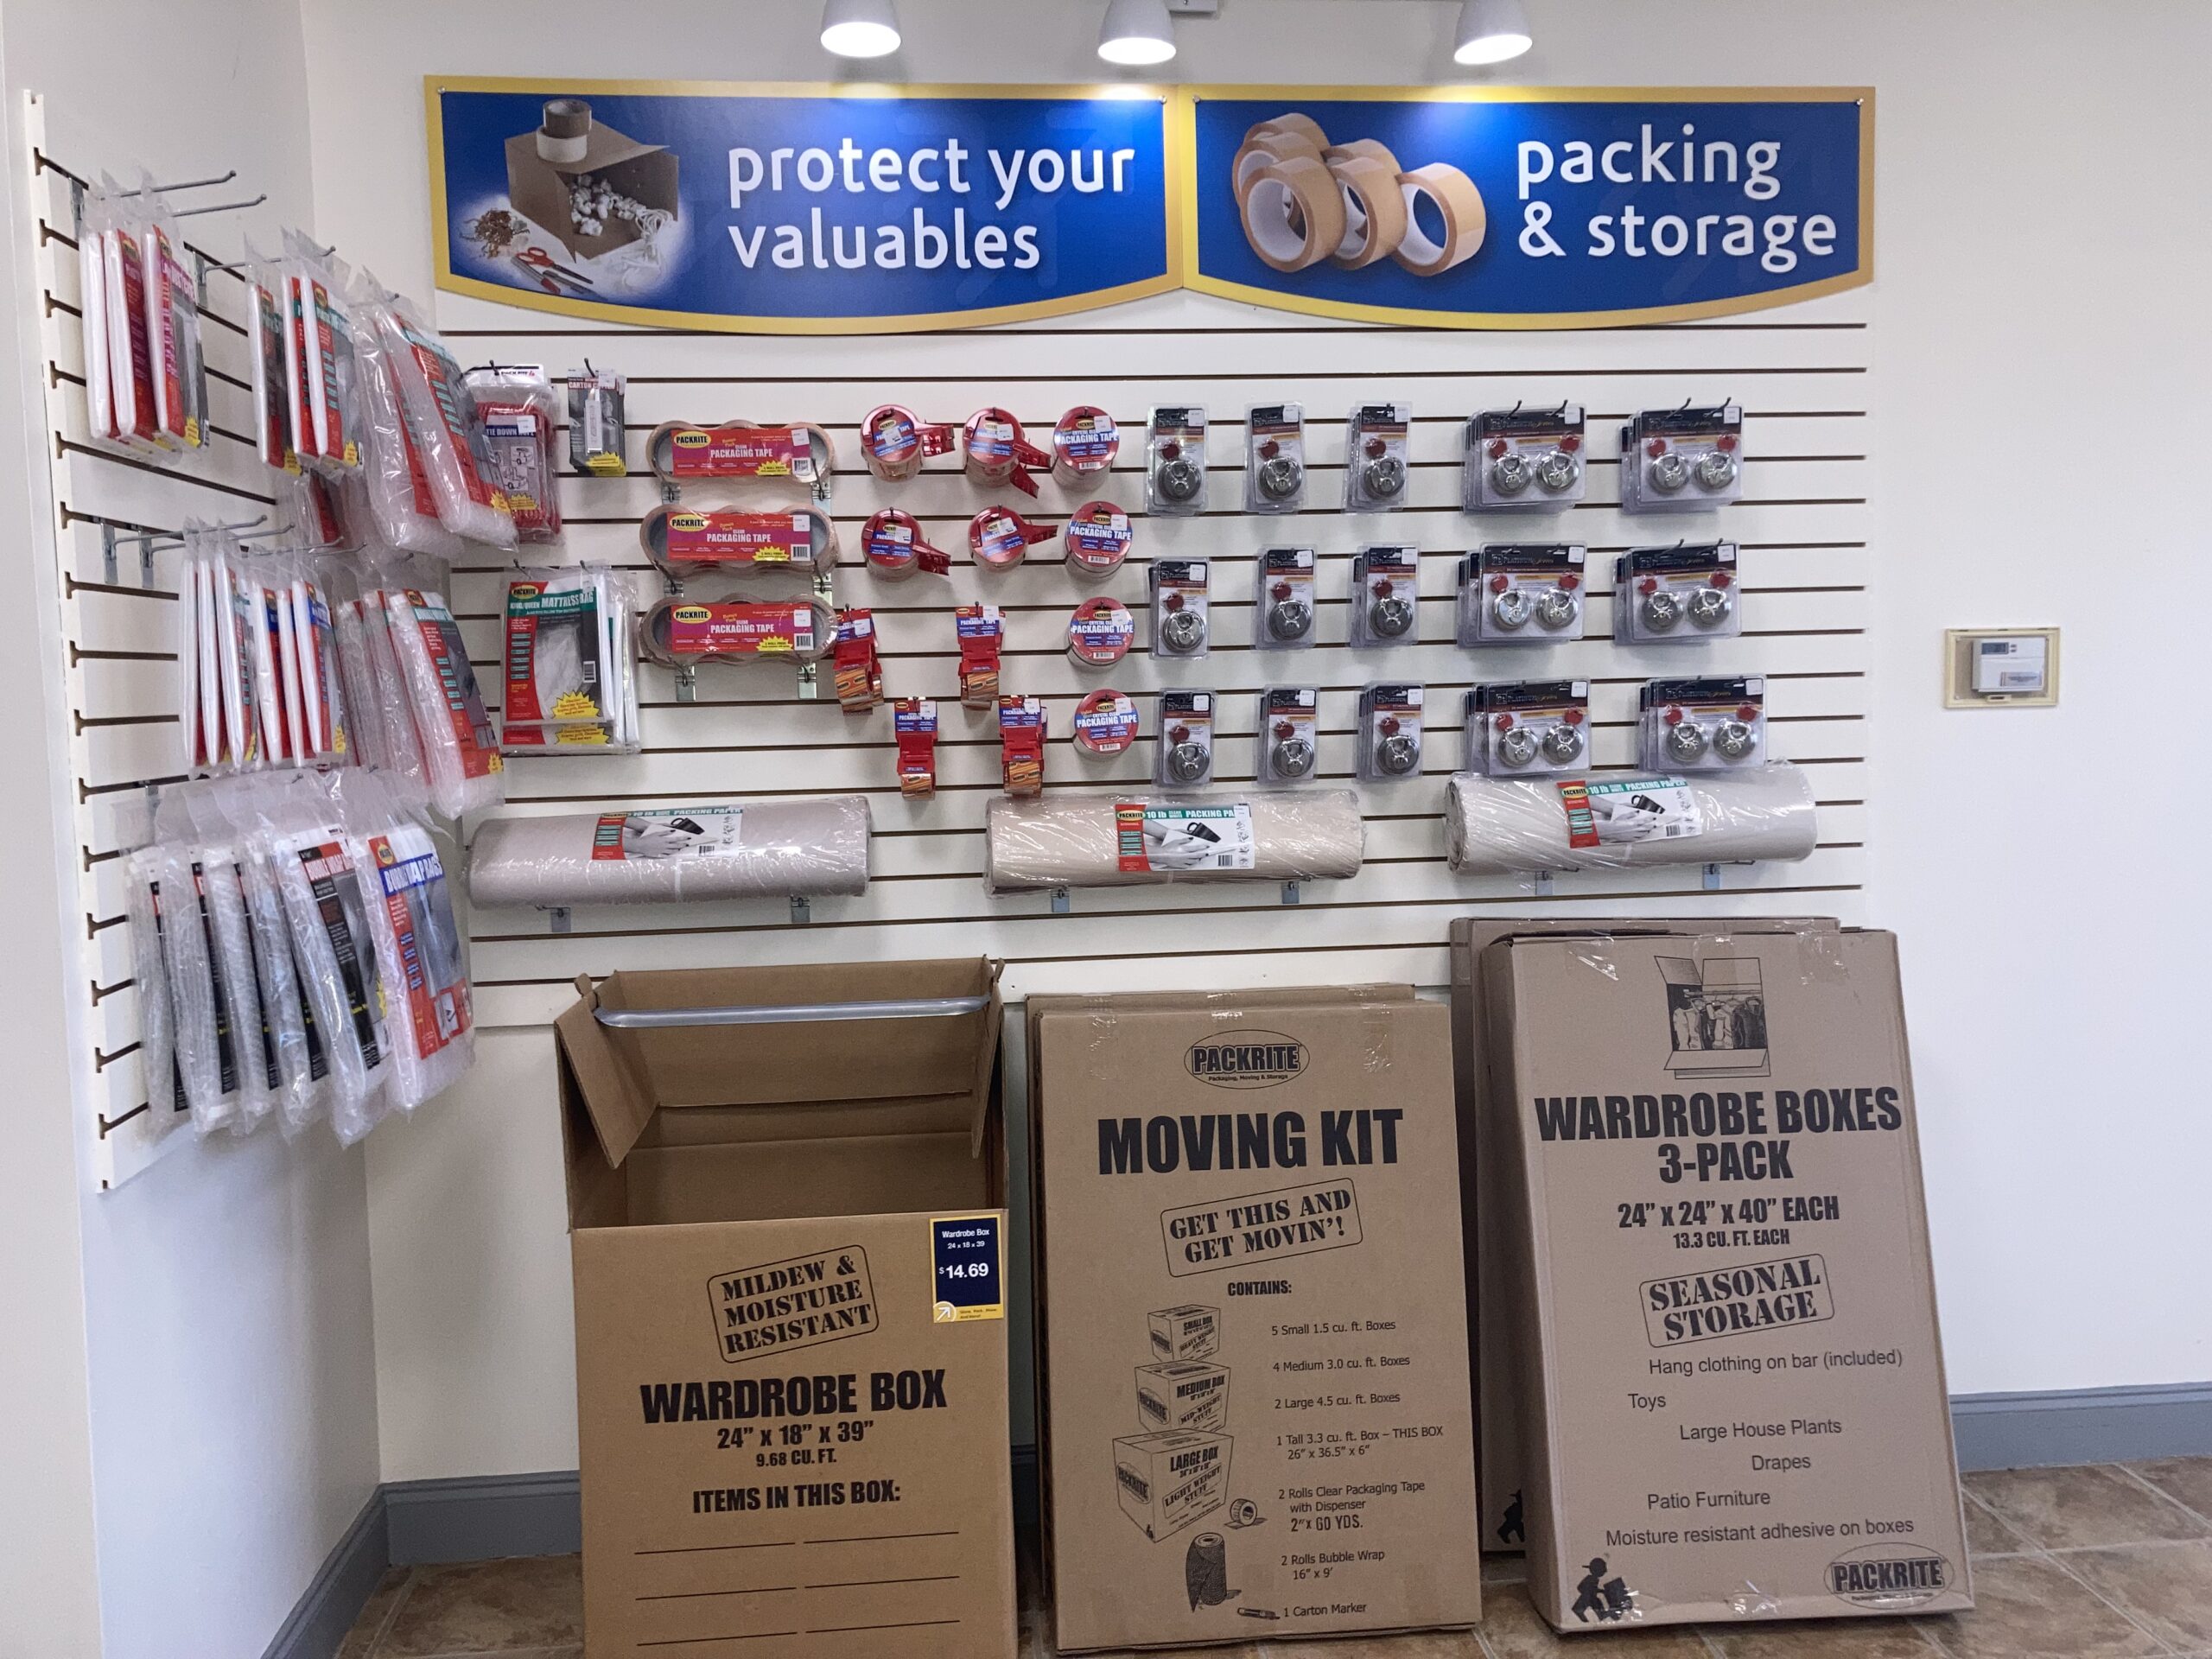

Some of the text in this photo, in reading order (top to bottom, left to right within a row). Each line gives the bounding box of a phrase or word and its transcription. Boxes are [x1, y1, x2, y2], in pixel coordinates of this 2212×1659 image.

[1517, 124, 1782, 200] packing
[729, 137, 1135, 209] protect your
[728, 207, 1039, 270] valuables
[1518, 202, 1837, 272] & storage
[677, 435, 708, 444] PACKRITE
[1100, 433, 1118, 442] TAPE
[710, 448, 772, 458] PACKAGING TAPE
[707, 533, 772, 543] PACKAGING TAPE
[1070, 526, 1132, 541] PACKAGING TAPE
[541, 592, 594, 608] MATTRESS BAG
[710, 624, 775, 633] PACKAGING TAPE
[1072, 625, 1134, 633] PACKAGING TAPE
[1077, 714, 1137, 728] PACKAGING TAPE
[1563, 787, 1586, 796] PACKRITE
[1588, 786, 1599, 795] 10
[1599, 785, 1609, 794] lb
[1624, 781, 1660, 791] PACKING
[1661, 779, 1688, 788] PAPER
[1146, 810, 1156, 819] 10
[1185, 810, 1222, 818] PACKING
[1192, 1046, 1300, 1073] PACKRITE
[1533, 1085, 1903, 1141] WARDROBE BOXES
[1097, 1108, 1404, 1175] MOVING KIT
[1656, 1140, 1795, 1184] 3-PACK
[1169, 1188, 1352, 1241] GET THIS AND
[1617, 1195, 1840, 1229] 24" 24" 40" EACH
[941, 1228, 990, 1239] Wardrobe Box
[1184, 1215, 1346, 1265] GET MOVIN'!
[1672, 1228, 1791, 1249] 13.3 CU. FT. EACH
[720, 1254, 857, 1302] MILDEW &
[1227, 1280, 1293, 1296] CONTAINS:
[1648, 1258, 1821, 1313] SEASONAL
[723, 1279, 864, 1328] MOISTURE
[1662, 1290, 1820, 1343] STORAGE
[723, 1303, 872, 1355] RESISTANT
[1281, 1320, 1396, 1335] Small 1.5 cu. ft. Boxes
[1273, 1357, 1410, 1372] 4 Medium 3.0 cu. ft. Boxes
[1648, 1348, 1904, 1377] Hang clothing on bar (included)
[639, 1368, 948, 1424] WARDROBE BOX
[1176, 1379, 1211, 1398] MEDIUM
[1274, 1393, 1401, 1410] 2 Large 4.5 cu. ft. Boxes
[1627, 1392, 1667, 1413] Toys
[716, 1420, 874, 1450] 24" 18" 39"
[1286, 1426, 1444, 1446] Tall 3.3 cu. ft. Box THIS BOX
[1679, 1418, 1842, 1444] Large House Plants
[755, 1447, 837, 1467] 9.68 CU. FT.
[1170, 1450, 1202, 1472] LARGE
[1202, 1446, 1219, 1462] BOX
[1287, 1447, 1306, 1459] 26"
[1751, 1454, 1811, 1473] Drapes
[1164, 1484, 1192, 1507] LIGHT
[1193, 1465, 1222, 1488] WEIGHT
[1278, 1481, 1426, 1499] 2 Rolls Clear Packaging Tape
[692, 1479, 900, 1514] ITEMS IN THIS BOX:
[1290, 1499, 1366, 1513] with Dispenser
[1648, 1490, 1771, 1510] Patio Furniture
[1336, 1514, 1363, 1530] YDS.
[1605, 1517, 1915, 1548] Moisture resistant adhesive on boxes
[1281, 1549, 1385, 1566] 2 Rolls Bubble Wrap
[1833, 1558, 1945, 1593] PACKRITE
[1293, 1602, 1368, 1618] Carton Marker
